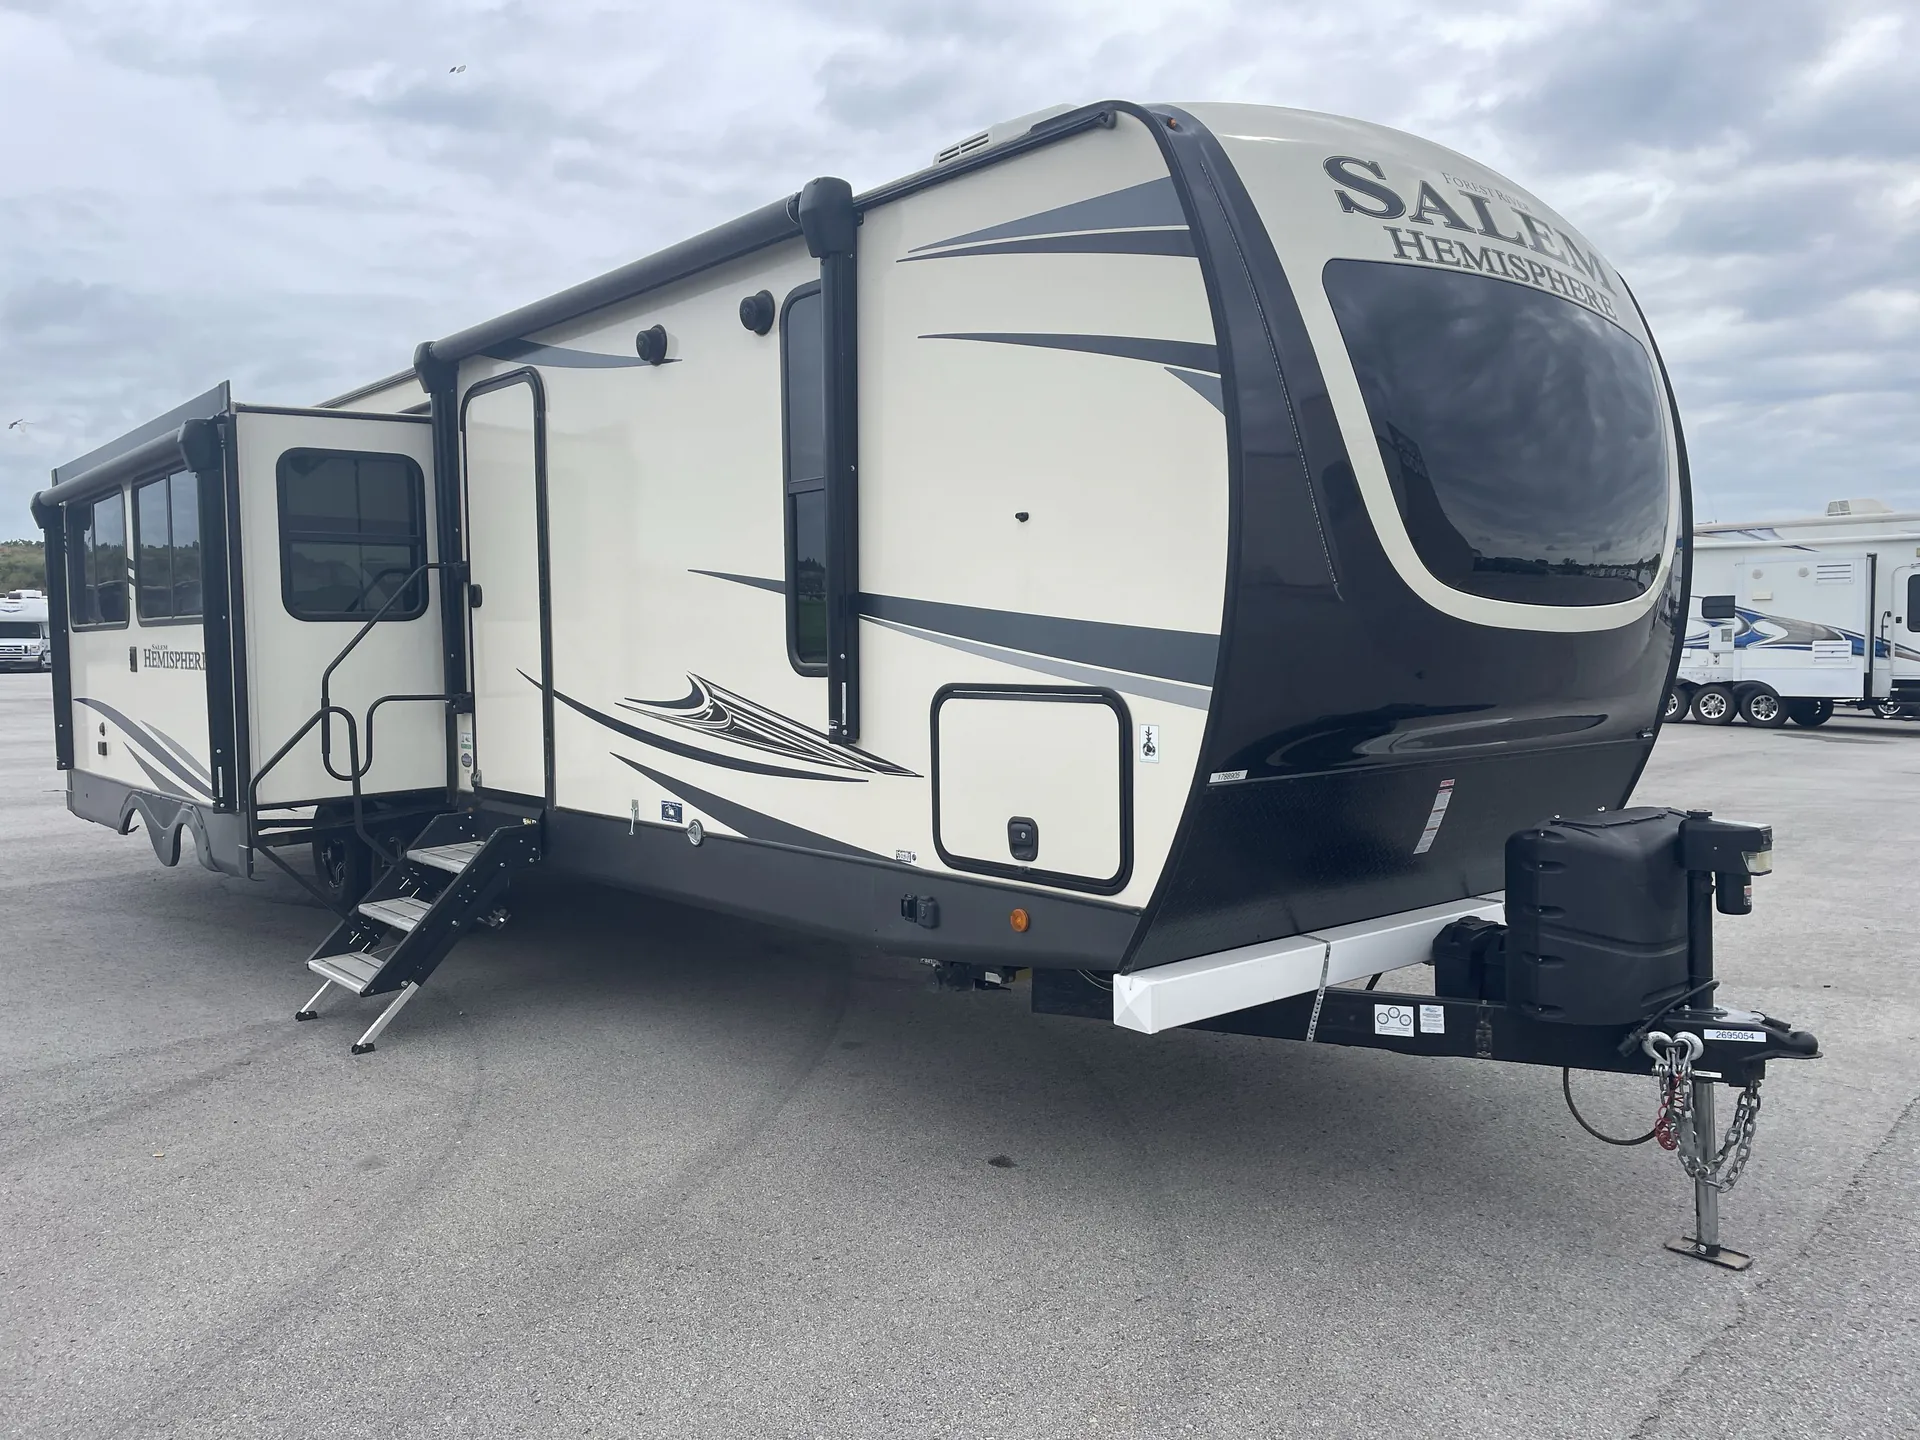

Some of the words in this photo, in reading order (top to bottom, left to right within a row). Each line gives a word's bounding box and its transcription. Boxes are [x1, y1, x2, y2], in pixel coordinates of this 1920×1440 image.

[1441, 171, 1495, 198] FOREST
[1322, 155, 1618, 299] SALEM
[1383, 225, 1618, 321] HEMISPHERE
[1716, 1031, 1754, 1040] 2695054
